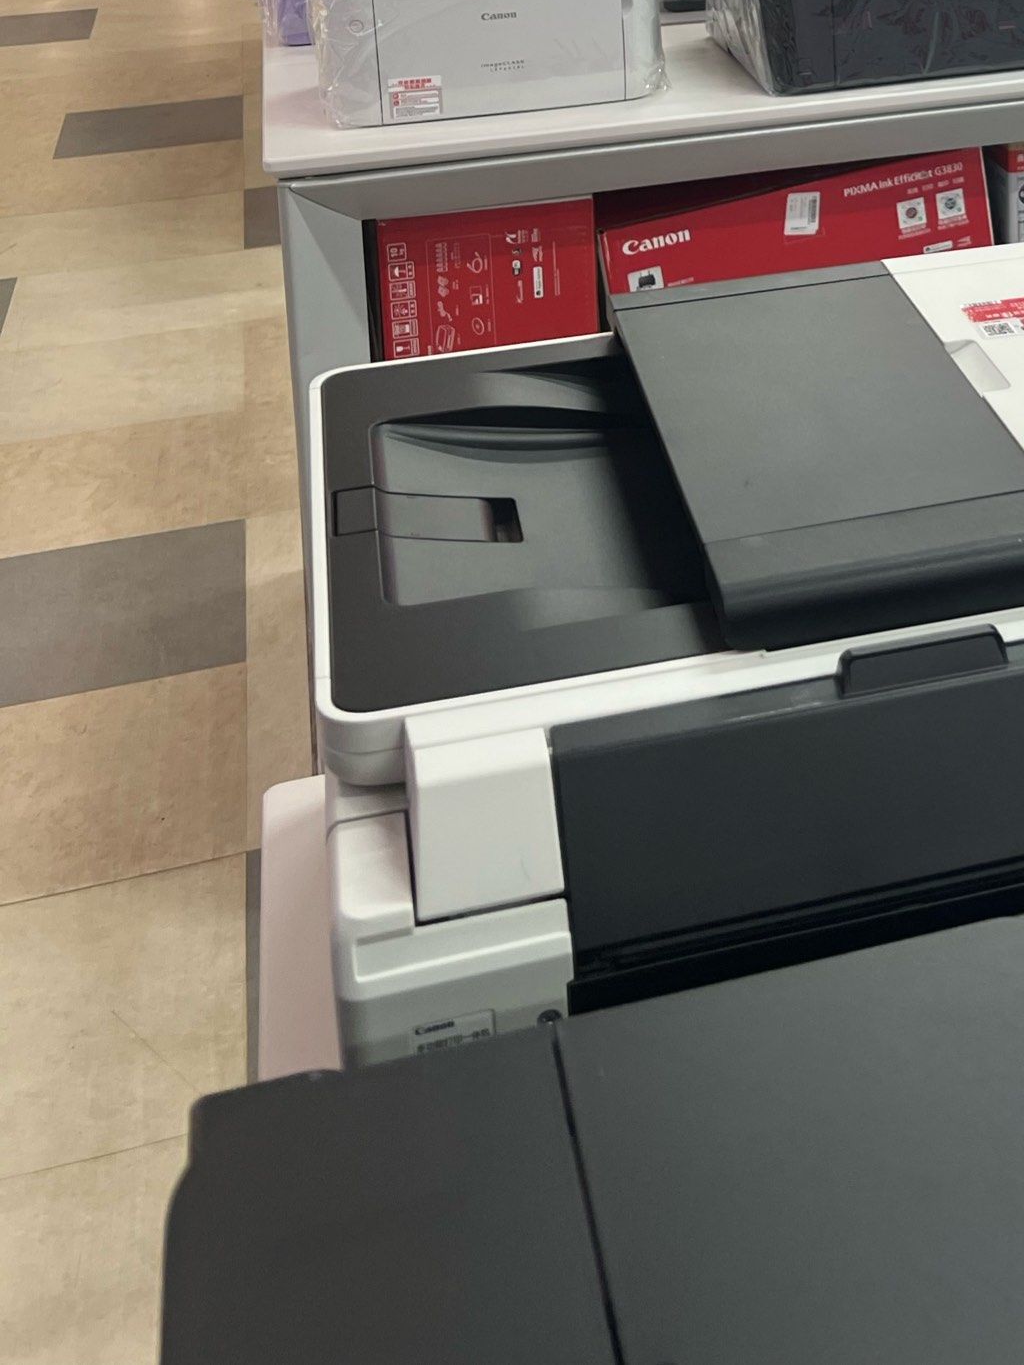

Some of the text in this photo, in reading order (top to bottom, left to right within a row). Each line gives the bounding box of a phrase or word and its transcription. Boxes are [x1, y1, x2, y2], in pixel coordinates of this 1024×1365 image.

[481, 11, 517, 21] Canon
[843, 182, 878, 197] PIXMA
[879, 178, 894, 190] Ink
[934, 162, 963, 177] G3830
[622, 228, 691, 255] Canon
[415, 1020, 454, 1035] Canon
